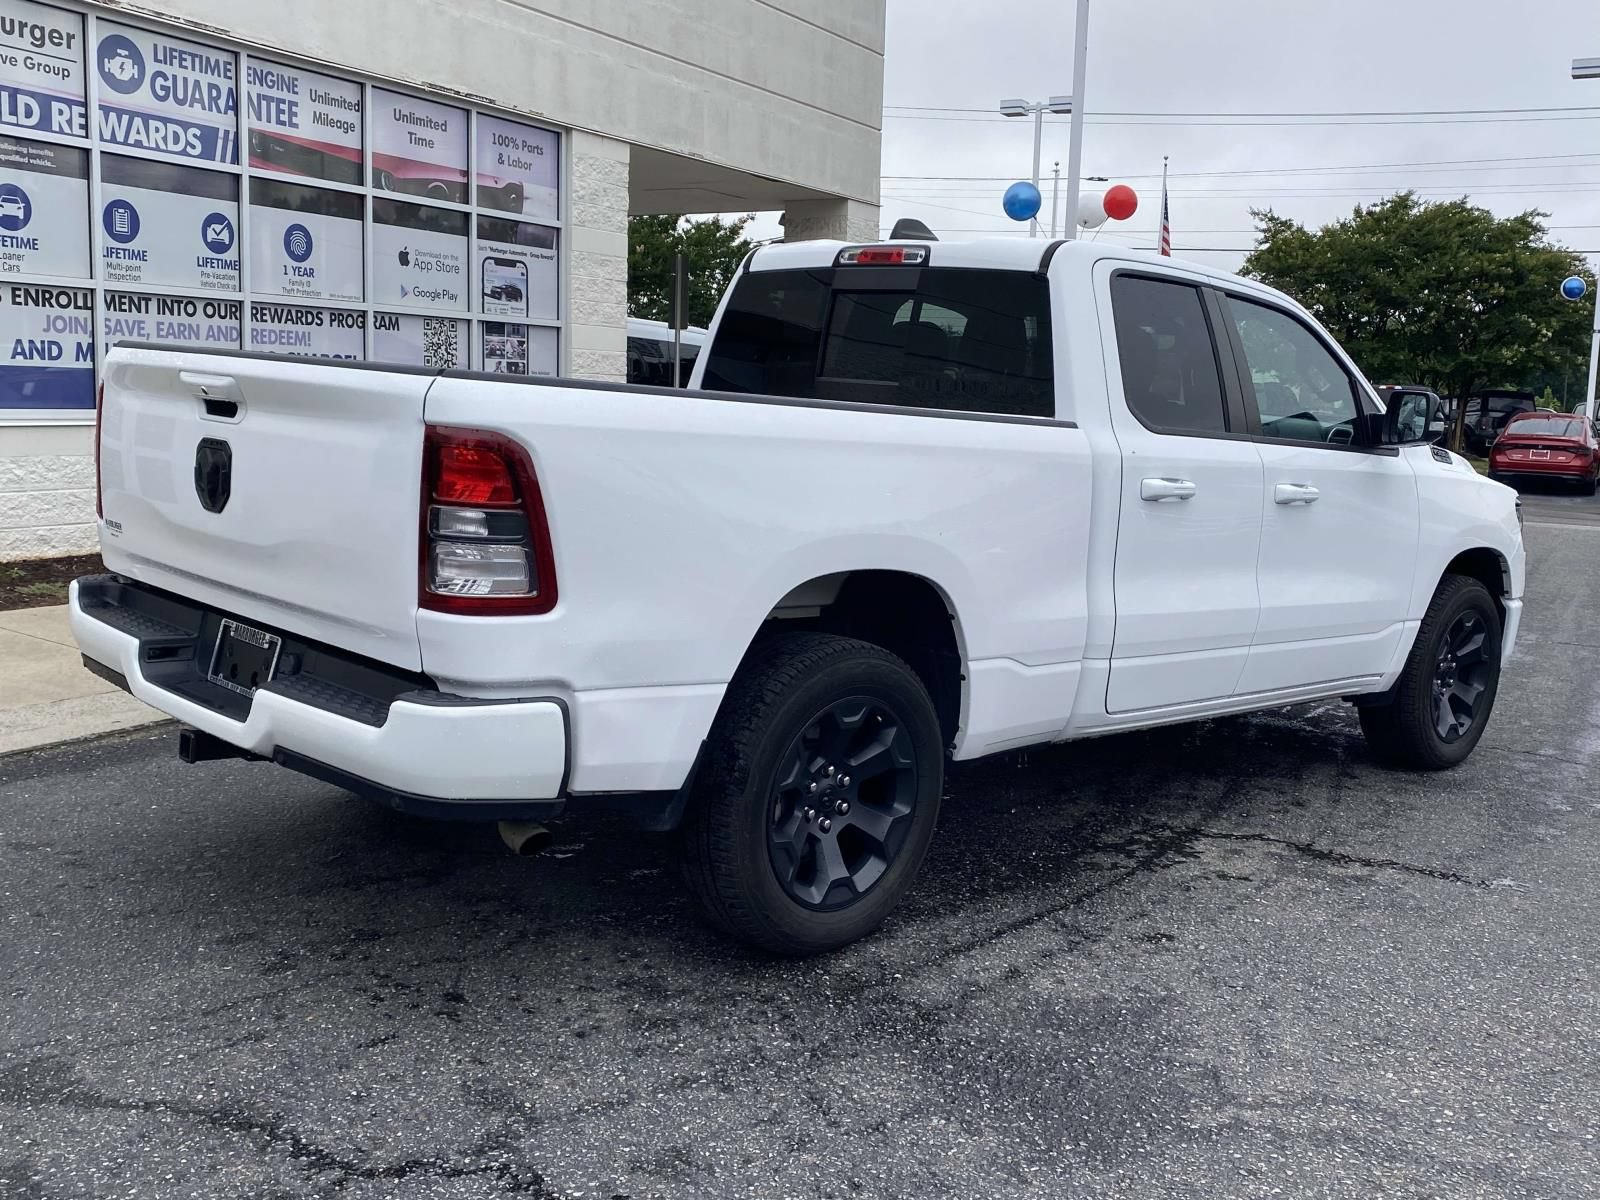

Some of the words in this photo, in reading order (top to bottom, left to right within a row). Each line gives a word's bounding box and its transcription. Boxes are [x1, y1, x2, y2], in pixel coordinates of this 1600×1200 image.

[23, 56, 71, 80] Group
[153, 43, 233, 81] LIFETIME
[246, 65, 299, 95] ENGINE
[309, 88, 361, 113] Unlimited
[312, 110, 356, 134] Mileage
[393, 108, 448, 132] Unlimited
[408, 131, 435, 149] Time
[492, 133, 519, 151] 100%
[521, 140, 544, 156] Parts
[497, 153, 505, 165] &
[507, 158, 533, 172] Labor
[197, 255, 240, 271] LIFETIME
[414, 249, 441, 259] Download
[2, 261, 21, 272] Cars
[106, 261, 142, 273] Multi-point
[283, 265, 288, 275] 1
[291, 266, 315, 278] YEAR
[413, 257, 433, 272] App
[435, 260, 460, 274] Store
[107, 271, 141, 281] Inspection
[412, 286, 441, 301] Google
[442, 289, 458, 303] Play
[156, 297, 198, 318] INTO
[202, 301, 240, 320] OUR
[250, 306, 324, 327] REWARDS
[104, 317, 151, 341] SAVE,
[156, 321, 201, 341] EARN
[205, 324, 240, 343] AND
[250, 328, 312, 347] REDEEM!
[10, 338, 63, 361] AND
